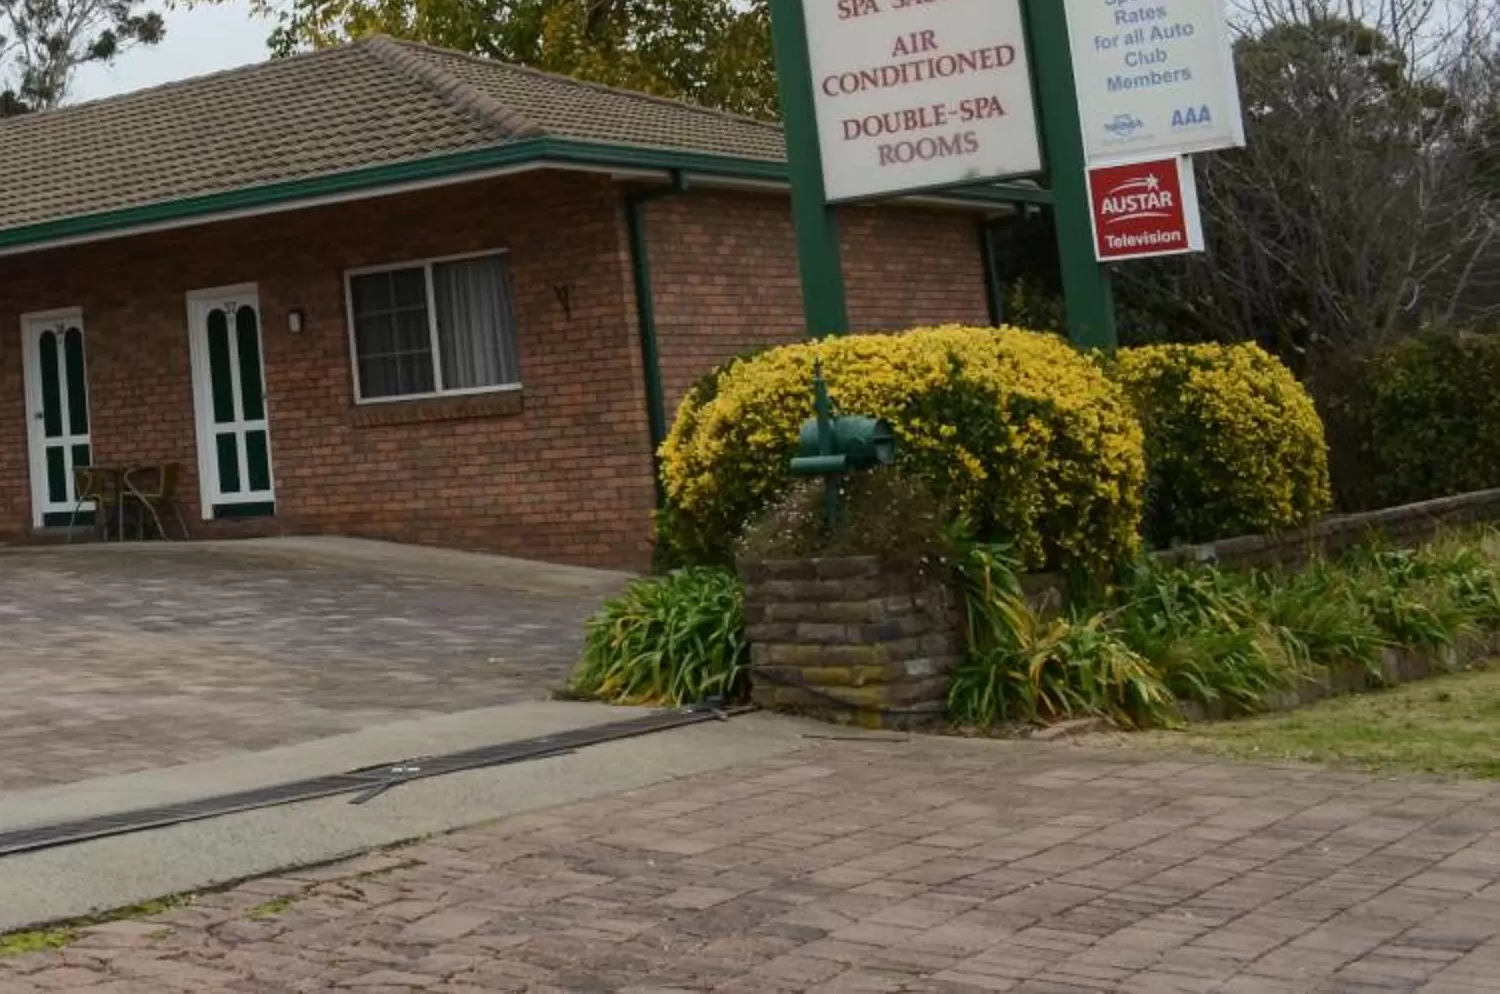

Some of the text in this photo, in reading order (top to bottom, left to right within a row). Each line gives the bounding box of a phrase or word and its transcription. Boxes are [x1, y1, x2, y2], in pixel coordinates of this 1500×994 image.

[1114, 5, 1166, 25] Rates
[892, 30, 938, 57] AIR
[1094, 22, 1194, 51] for all Auto
[822, 44, 1015, 97] CONDITIONED
[1124, 48, 1167, 67] Club
[1107, 66, 1192, 92] Members
[843, 96, 1006, 141] DOUBLE-SPA
[1171, 104, 1211, 127] AAA
[877, 130, 979, 166] ROOMS
[1101, 190, 1173, 215] AUSTAR
[1105, 229, 1181, 249] Television
